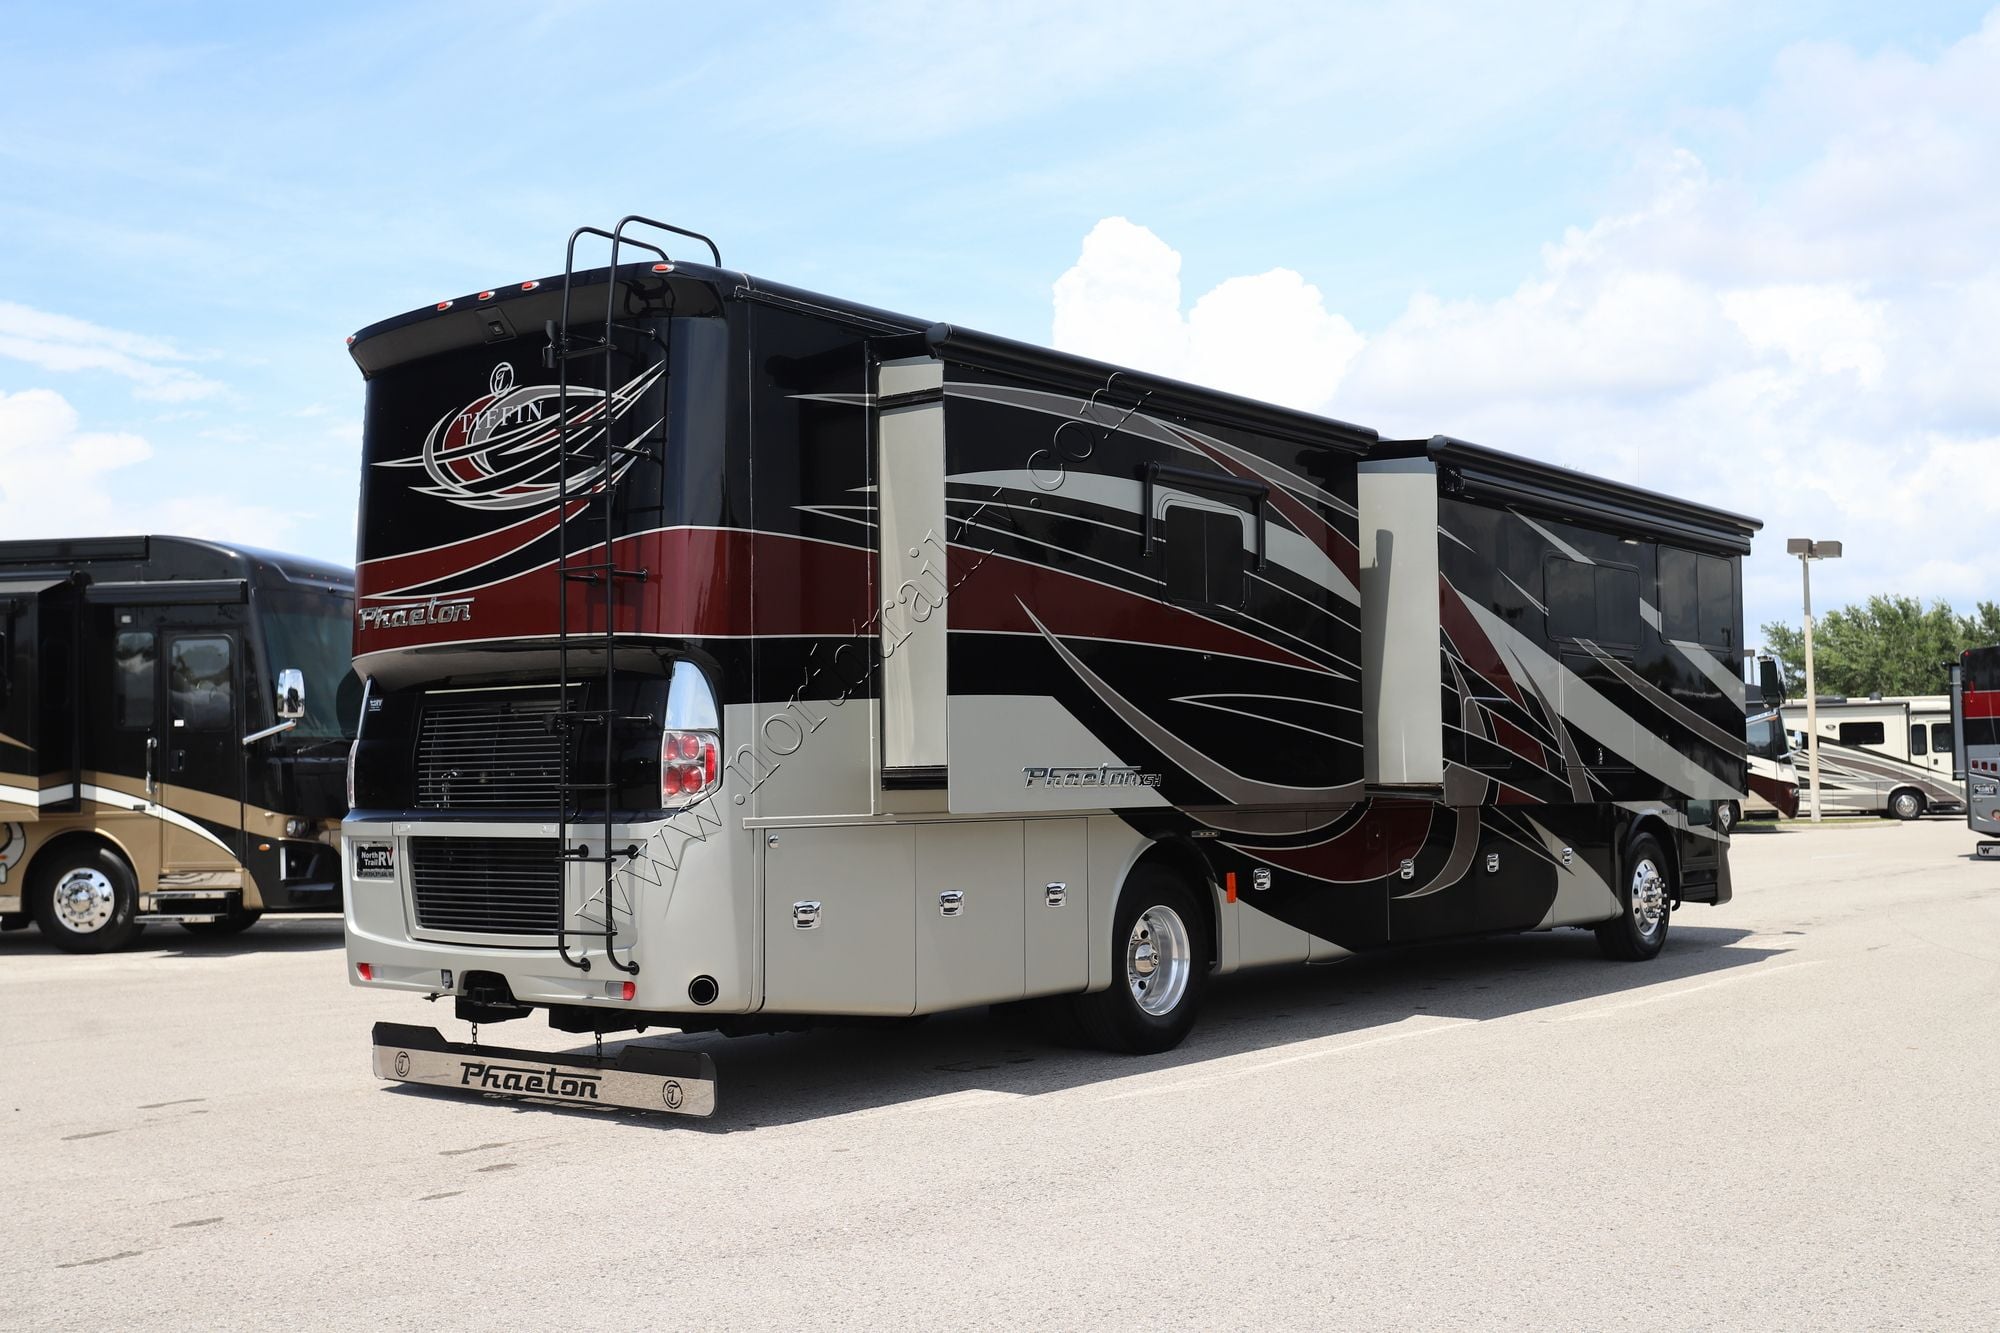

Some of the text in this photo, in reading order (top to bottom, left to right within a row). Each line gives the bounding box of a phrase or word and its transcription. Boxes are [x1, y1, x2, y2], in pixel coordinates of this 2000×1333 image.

[458, 400, 544, 433] TIFFIN
[358, 596, 475, 631] Phaeton
[1021, 762, 1142, 789] Phaeton
[361, 851, 379, 859] North
[364, 858, 379, 866] Trail
[378, 851, 394, 866] RV
[460, 1061, 602, 1099] Phaeton
